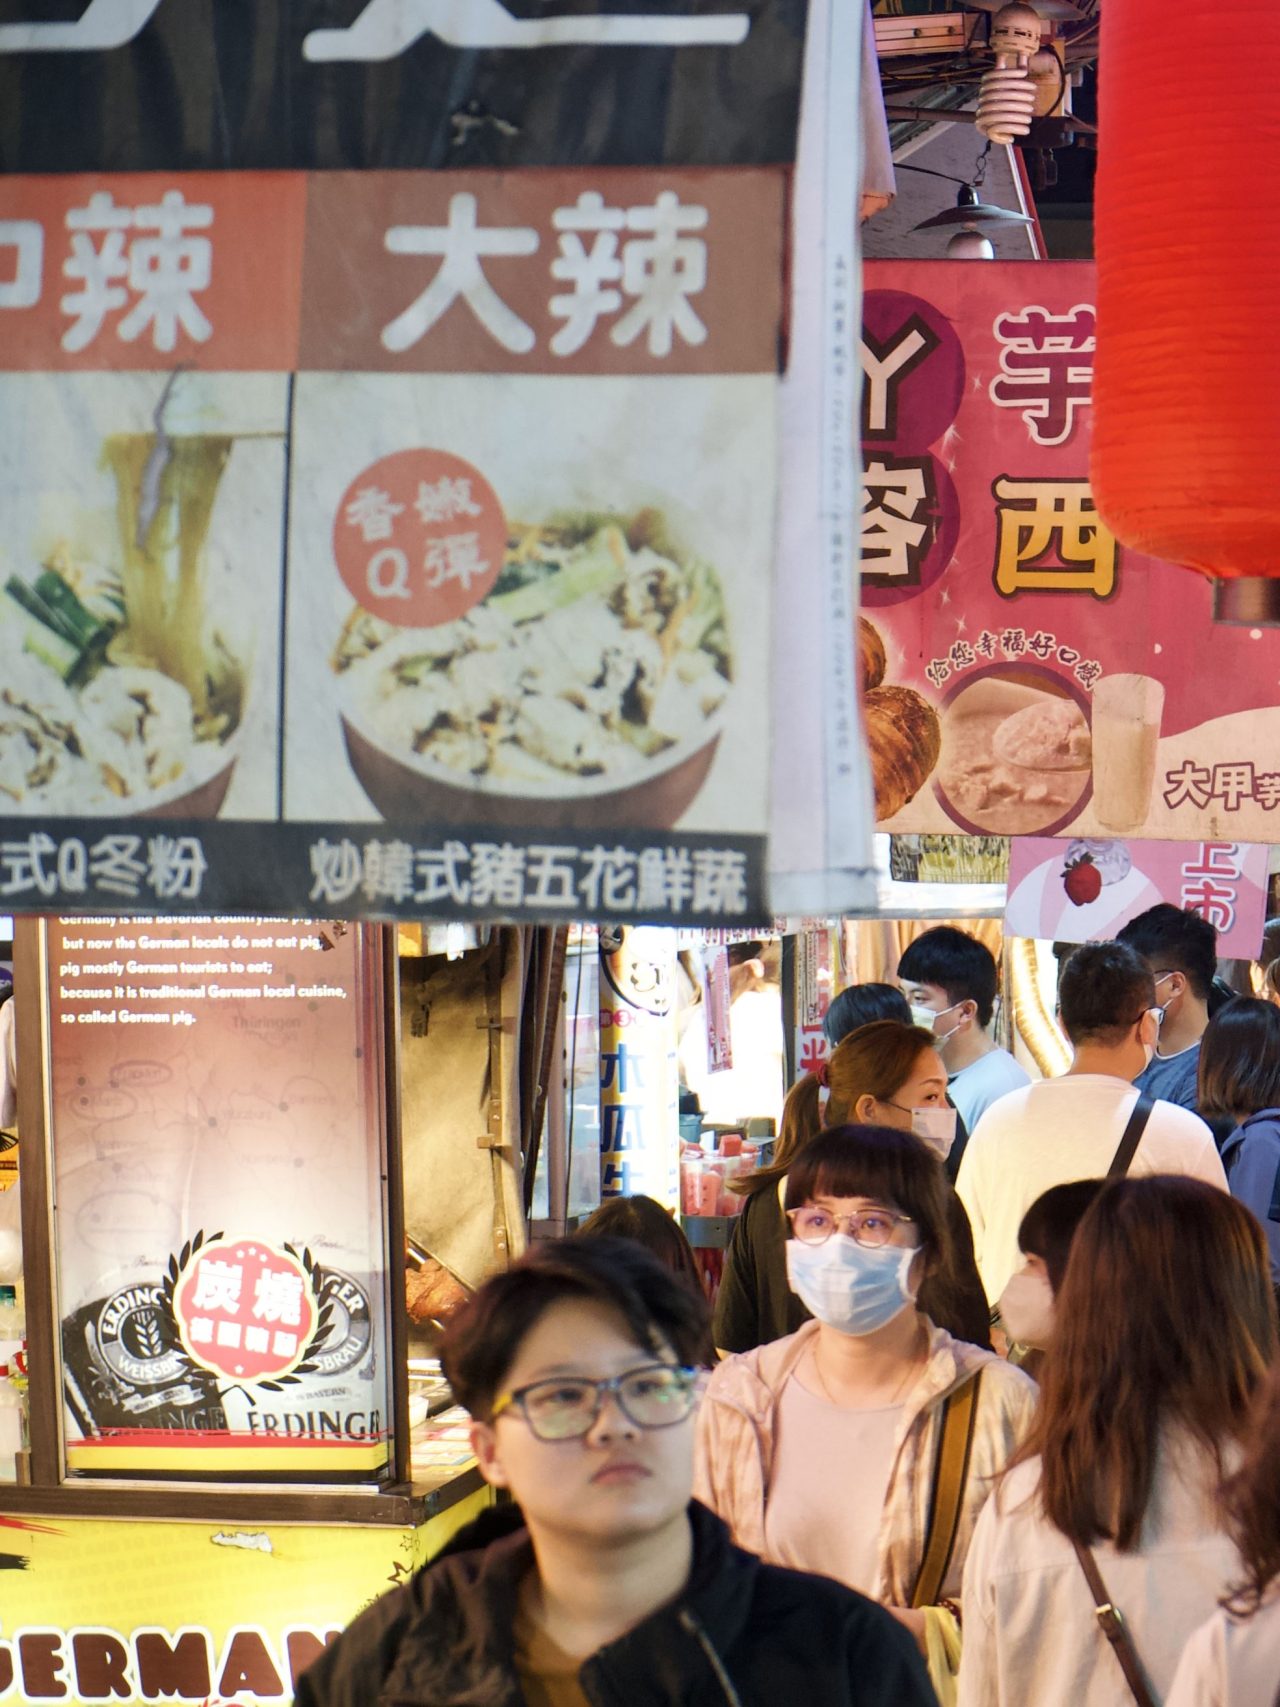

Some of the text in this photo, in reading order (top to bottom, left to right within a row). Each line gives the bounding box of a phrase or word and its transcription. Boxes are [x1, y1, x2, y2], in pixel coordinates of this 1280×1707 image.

[380, 191, 708, 358] 大辣
[927, 631, 1101, 688] 給您幸福好口感
[309, 838, 747, 914] 炒韓式豬五花鮮蔬
[62, 936, 85, 950] but
[86, 938, 113, 949] now
[115, 936, 136, 949] the
[138, 936, 190, 949] German
[191, 936, 230, 949] locals
[231, 935, 249, 949] do
[251, 937, 273, 949] not
[275, 937, 298, 948] eat
[60, 960, 273, 976] pig mostly German tourists to eat;
[60, 985, 348, 999] because it is traditional German local cuisine,
[60, 1010, 197, 1026] so called German pig.
